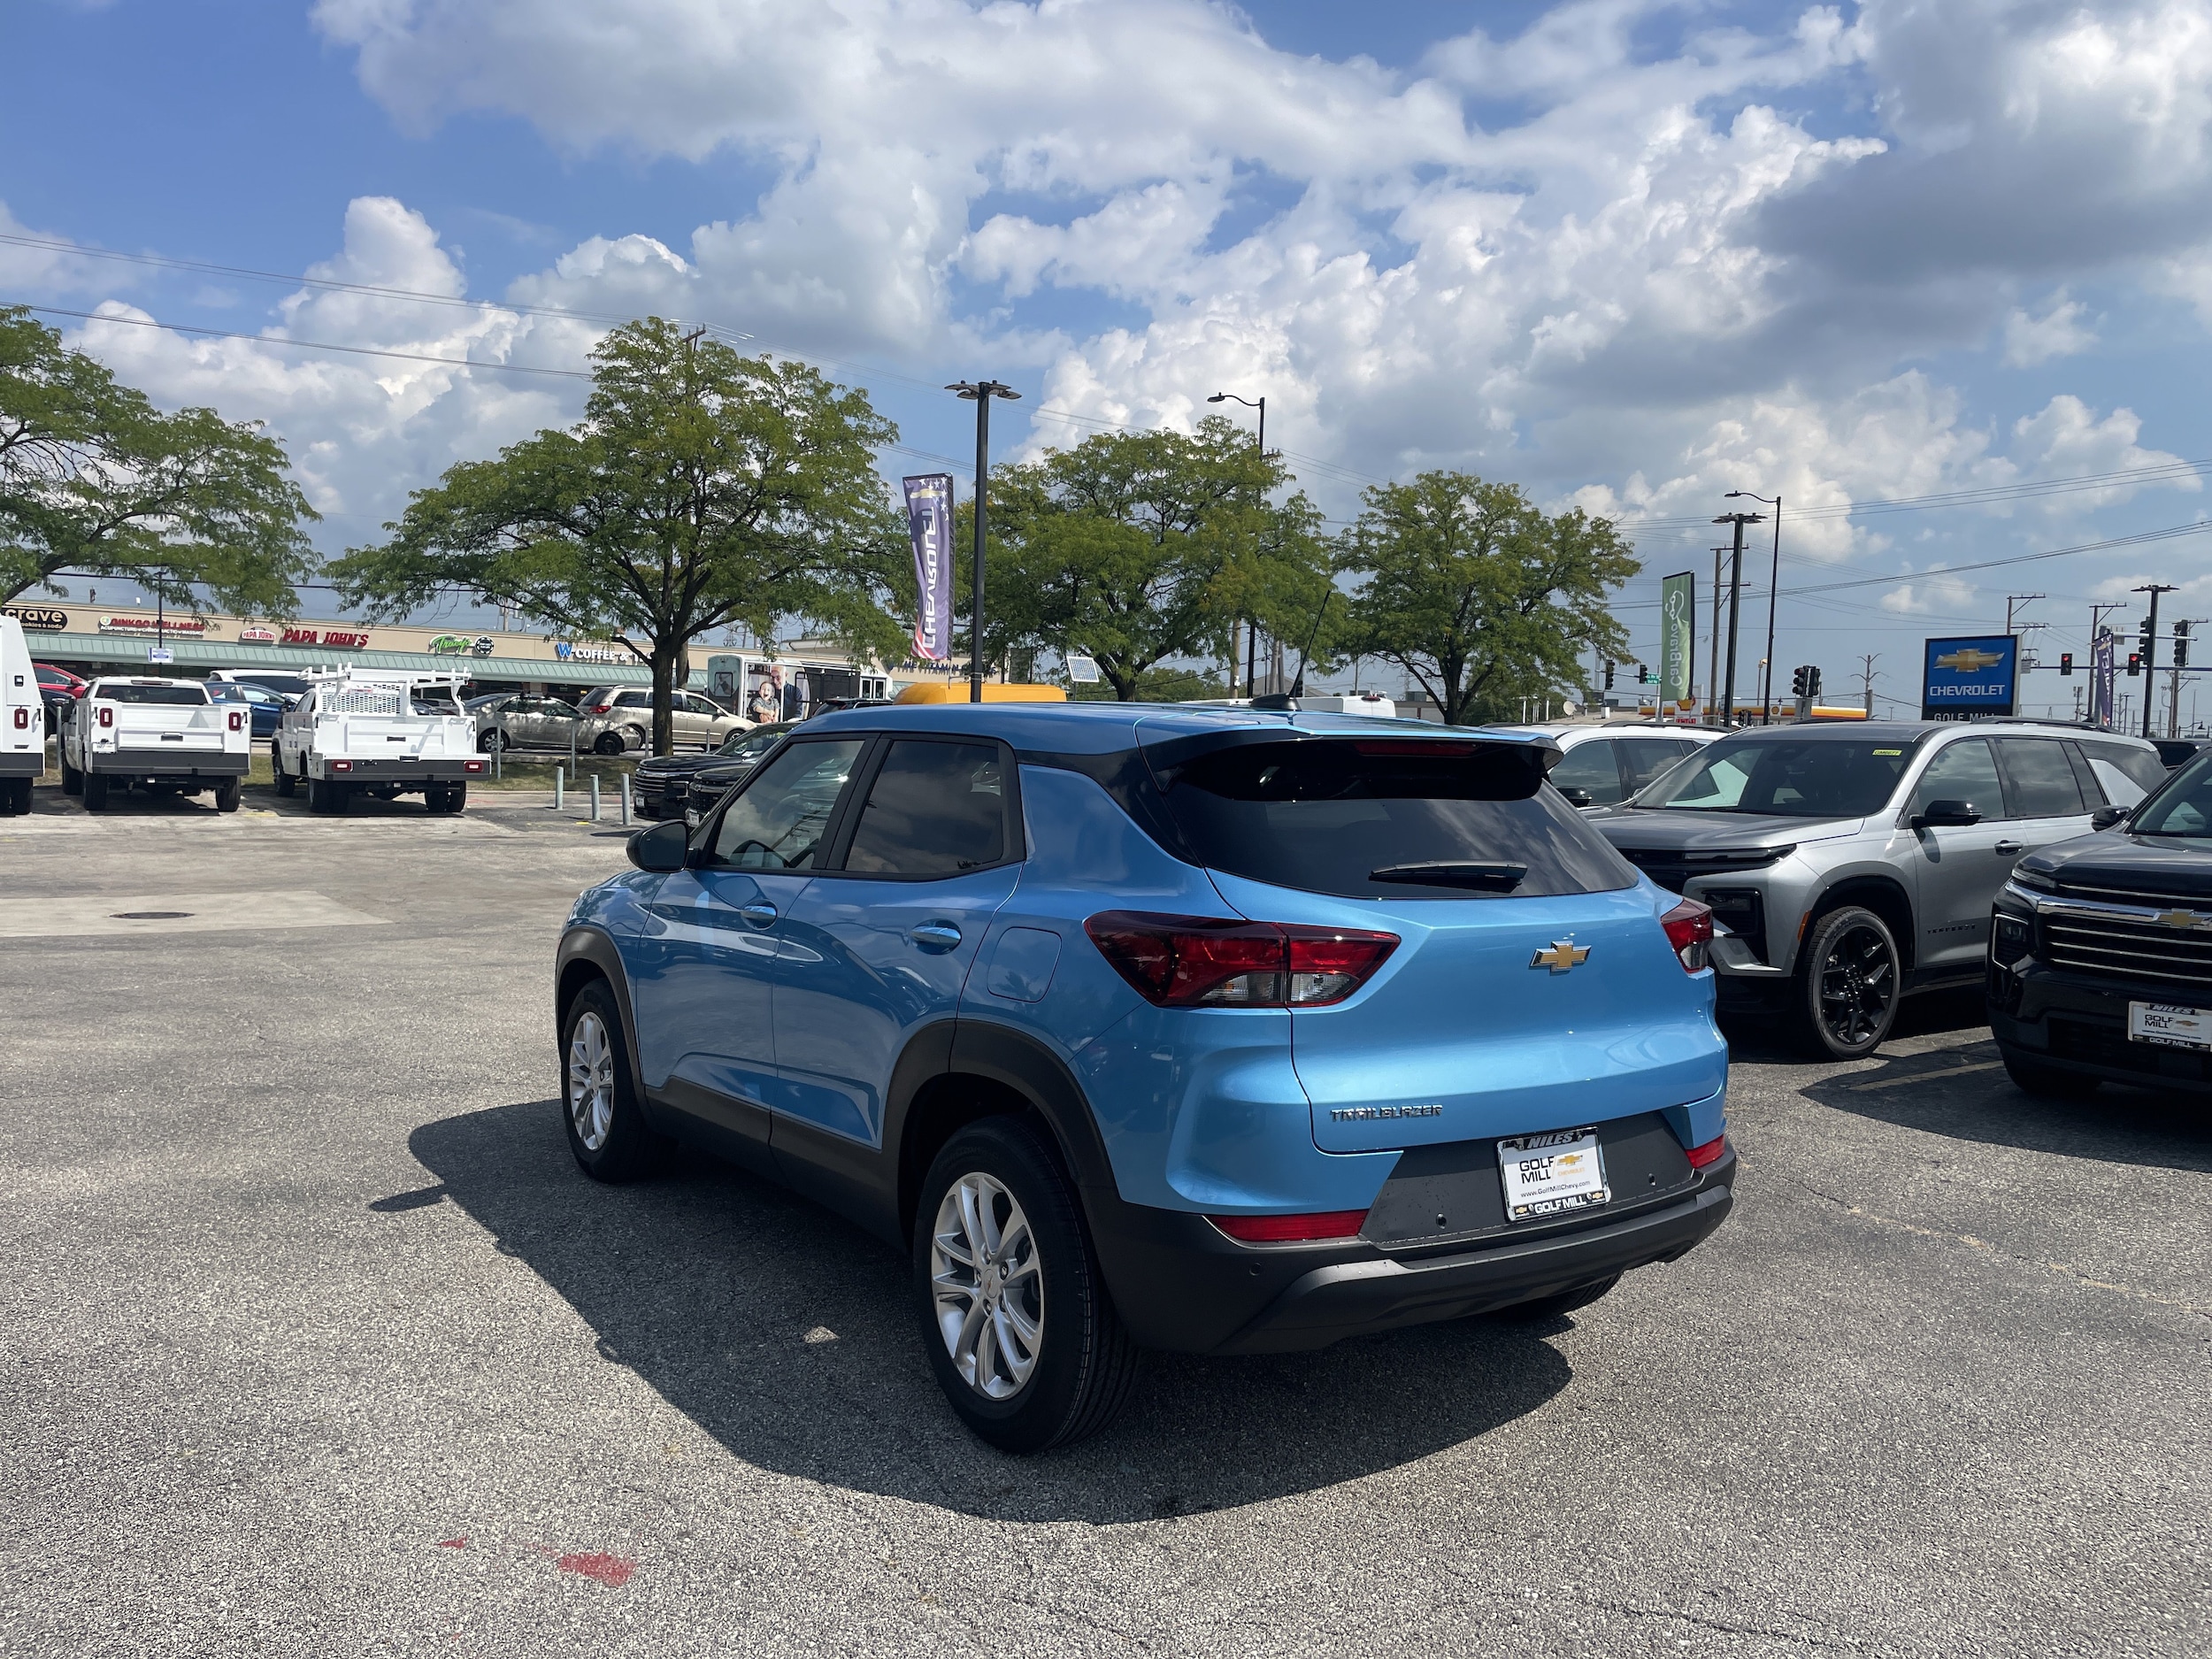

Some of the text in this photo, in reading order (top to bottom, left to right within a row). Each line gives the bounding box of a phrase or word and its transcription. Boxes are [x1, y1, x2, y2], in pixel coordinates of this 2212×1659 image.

[5, 609, 63, 623] crave
[111, 618, 150, 626] GINKGO
[282, 628, 369, 647] PAPA JOHN'S
[557, 641, 573, 657] W
[575, 649, 616, 661] COFFEE
[619, 651, 629, 662] &
[1929, 685, 2005, 696] CHEVROLET
[2151, 1004, 2193, 1015] NILES
[2145, 1014, 2175, 1023] GOLF
[2145, 1020, 2170, 1029] MILL
[2172, 1040, 2194, 1048] MILL
[1330, 1104, 1443, 1122] TRAILBLAZER
[1527, 1132, 1574, 1149] NILES
[1519, 1156, 1555, 1172] GOLF
[1521, 1168, 1552, 1185] MILL
[1520, 1179, 1591, 1198] www.GolfMillChevy.com
[1533, 1195, 1587, 1215] GOLF MILL
